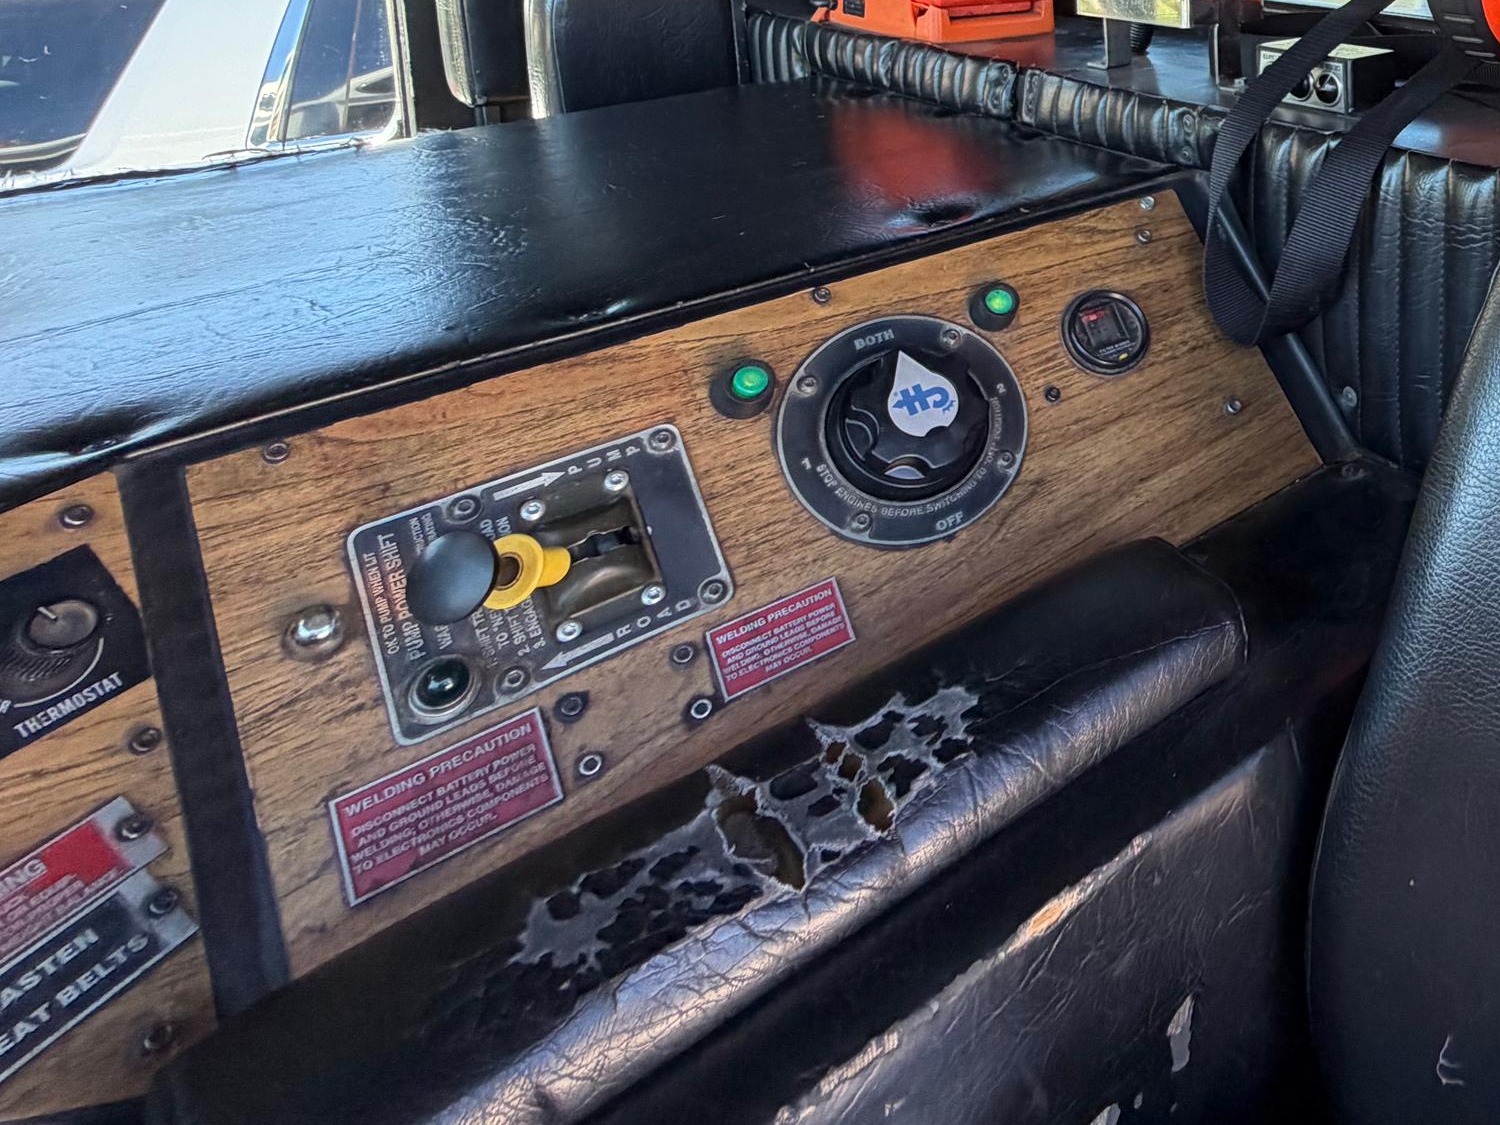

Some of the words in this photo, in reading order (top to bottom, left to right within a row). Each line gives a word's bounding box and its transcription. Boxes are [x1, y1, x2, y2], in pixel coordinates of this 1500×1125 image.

[854, 329, 895, 351] BOTH
[816, 463, 838, 486] STOP
[834, 487, 878, 513] ENGINES
[881, 504, 924, 518] BEFORE
[926, 481, 977, 513] SWITCHING
[935, 511, 965, 532] OFF
[363, 550, 377, 567] LIT
[377, 530, 403, 570] SHIFT
[367, 565, 385, 596] WHEN
[374, 594, 393, 623] PUMP
[616, 599, 693, 639] ROAD
[715, 617, 766, 645] WELDING
[766, 588, 831, 622] PRECAUTION
[810, 615, 842, 634] DAMAGE
[382, 623, 396, 637] TO
[384, 635, 400, 654] OK
[401, 620, 427, 660] PUMP
[496, 632, 510, 650] TO
[508, 614, 527, 645] SHIFT
[721, 631, 772, 659] DISCONNECT
[772, 615, 807, 635] BATTERY
[807, 602, 835, 619] POWER
[727, 652, 744, 664] AND
[744, 636, 779, 656] GROUND
[779, 624, 805, 639] LEADS
[805, 610, 835, 627] BEFORE
[725, 672, 738, 683] TO
[738, 646, 792, 677] ELECTRONICS
[793, 621, 845, 650] COMPONENTS
[765, 661, 782, 672] MAY
[13, 672, 123, 738] THERMOSTAT
[344, 771, 426, 817] WELDING
[428, 723, 531, 779] PRECAUTION
[350, 791, 434, 837] DISCONNECT
[435, 765, 490, 797] BATTERY
[491, 743, 536, 770] POWER
[495, 762, 546, 792] DAMAGE
[357, 827, 386, 847] AND
[388, 799, 444, 832] GROUND
[446, 779, 486, 804] LEADS
[487, 755, 535, 783] BEFORE
[354, 860, 374, 876] TO
[375, 815, 464, 865] ELECTRONICS
[466, 773, 549, 819] COMPONENTS
[419, 836, 447, 856] MAY
[56, 933, 149, 1008] BELTS
